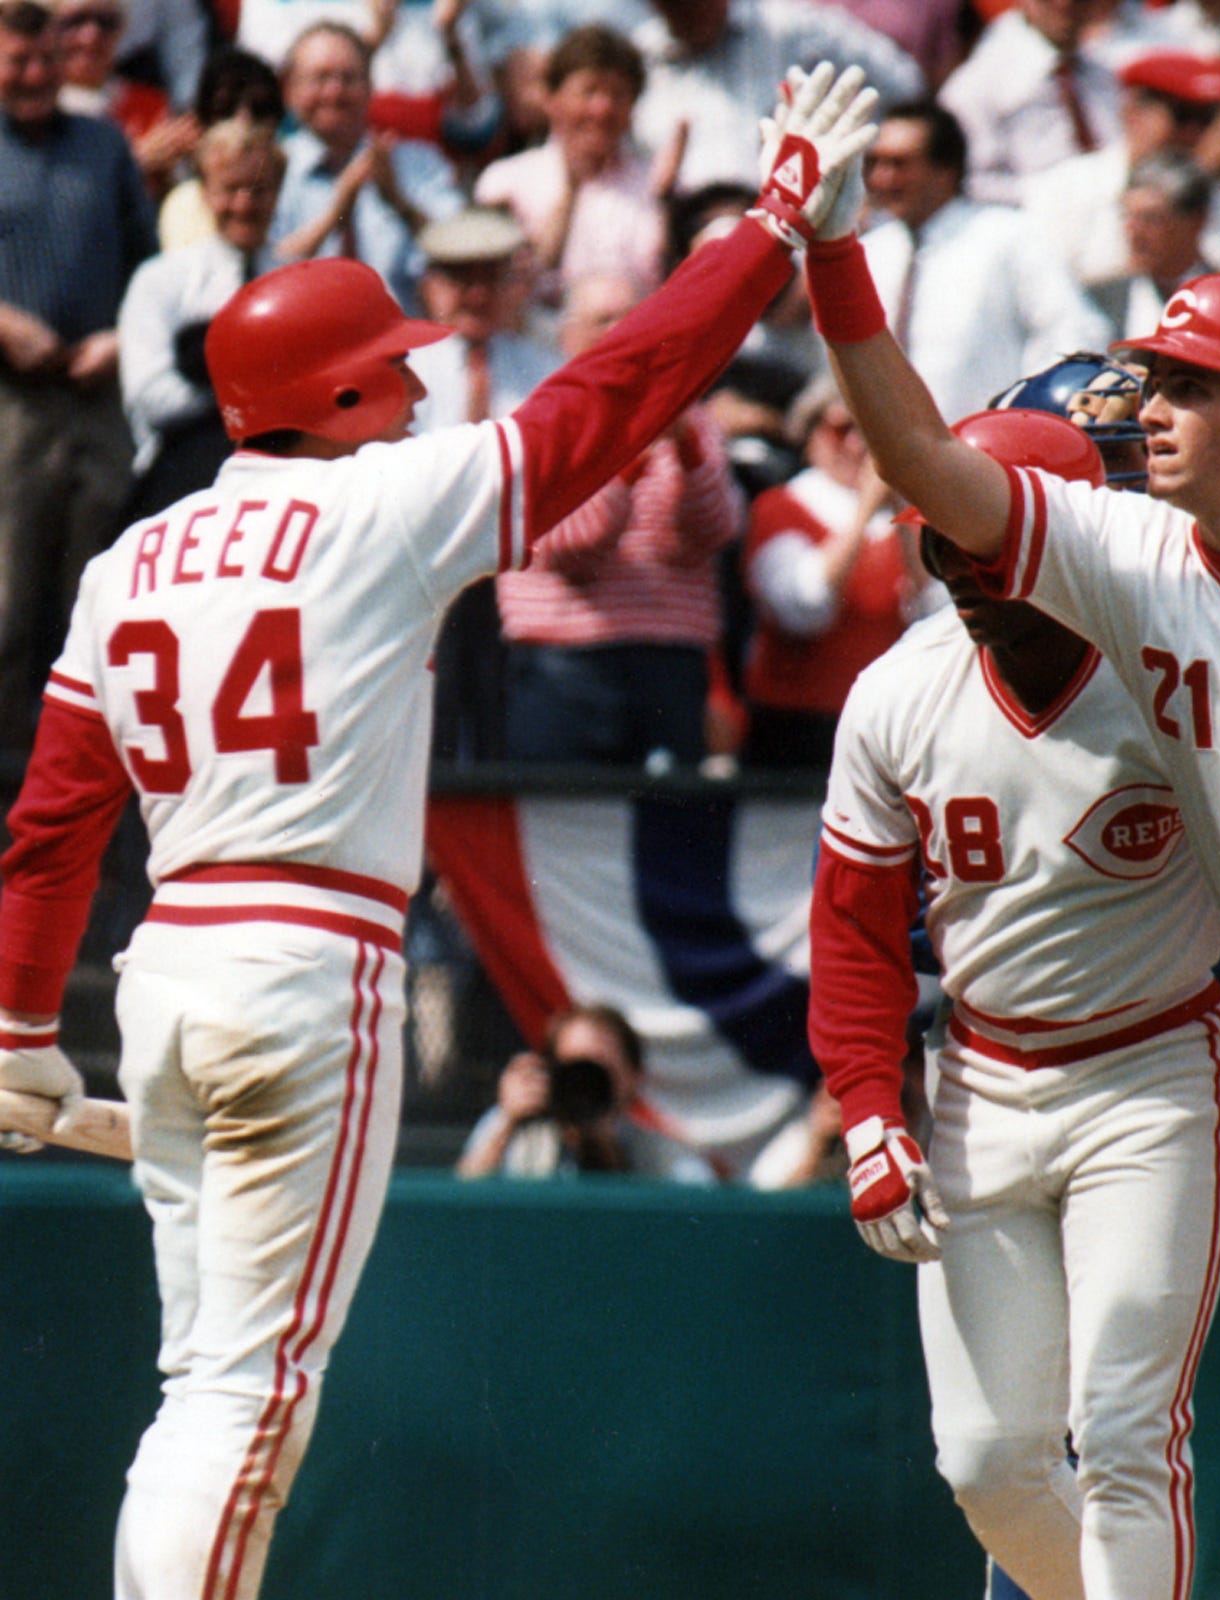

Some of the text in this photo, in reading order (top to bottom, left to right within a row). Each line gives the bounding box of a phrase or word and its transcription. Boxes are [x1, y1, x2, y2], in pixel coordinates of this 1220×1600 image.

[1160, 289, 1197, 328] C
[130, 498, 320, 600] REED
[106, 607, 320, 796] 34
[1141, 645, 1212, 749] 21
